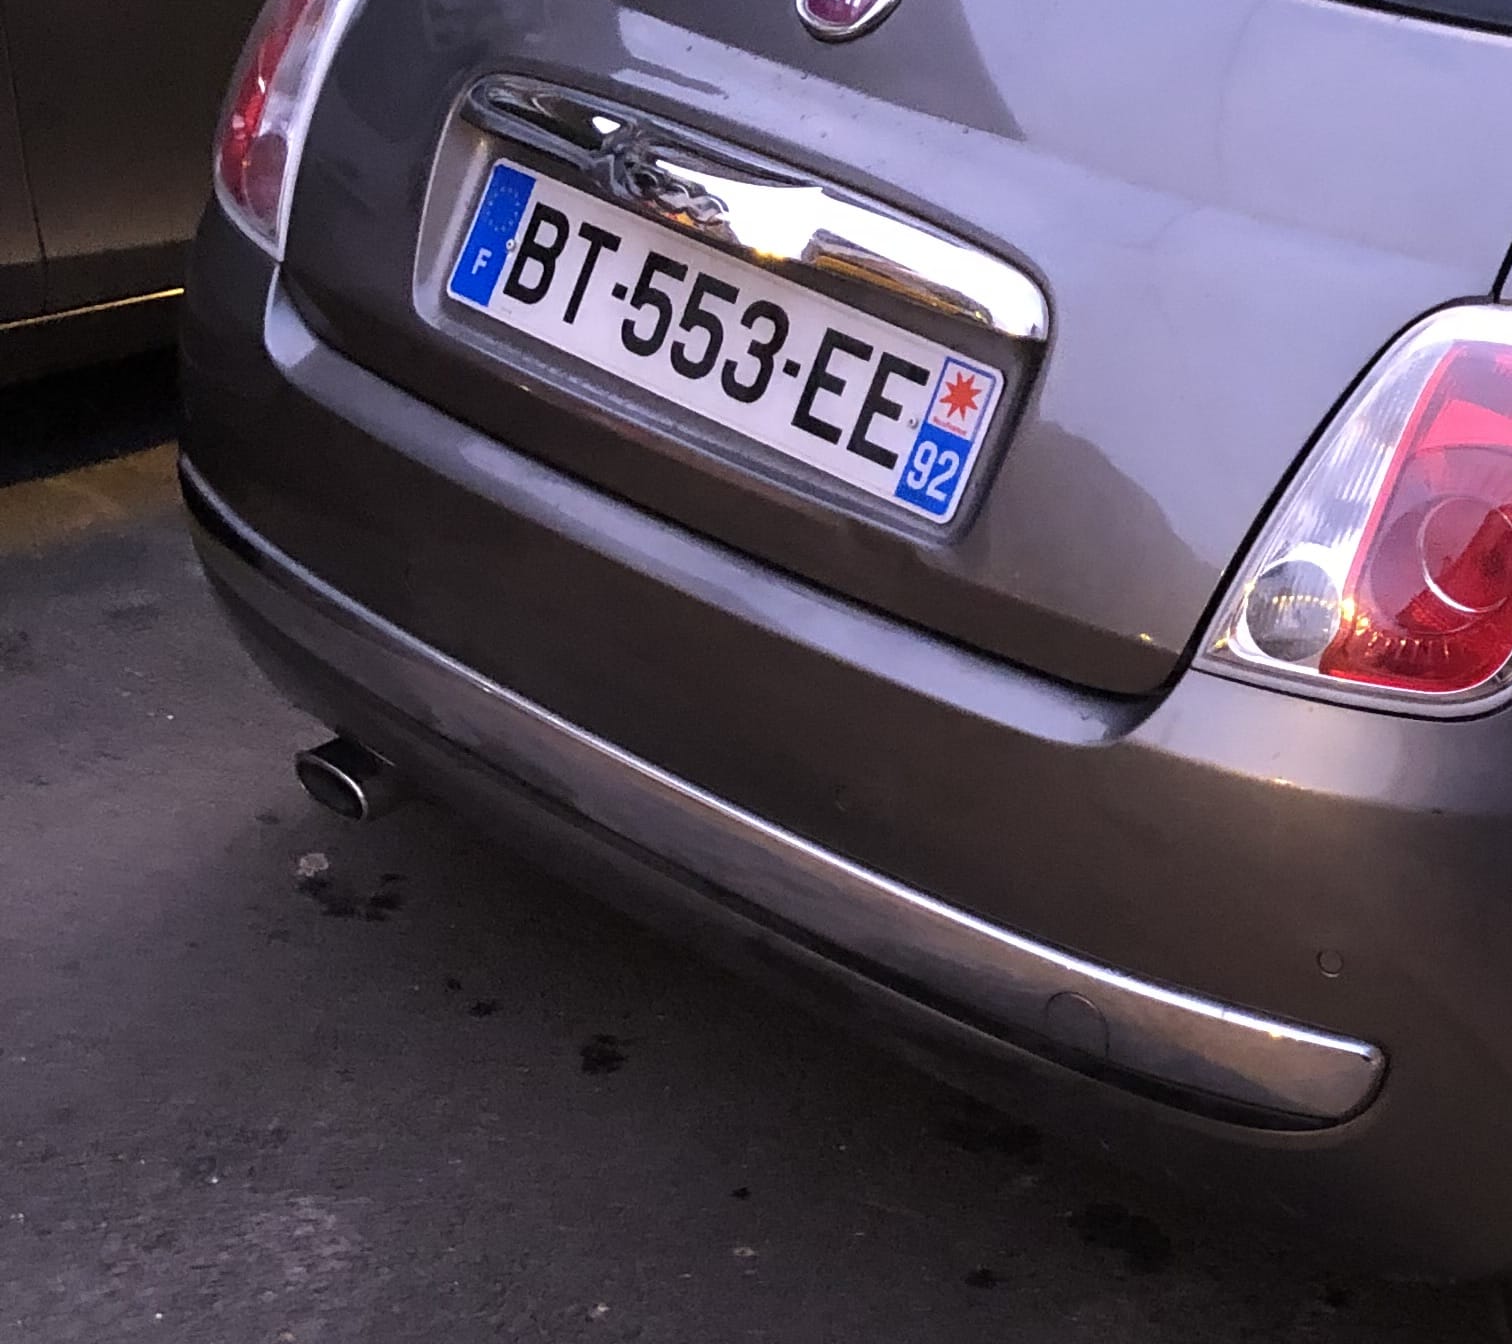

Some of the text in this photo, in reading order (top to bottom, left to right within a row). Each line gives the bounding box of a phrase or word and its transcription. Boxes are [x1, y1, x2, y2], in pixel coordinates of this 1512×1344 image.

[471, 247, 493, 275] F
[502, 201, 930, 470] BT-553-EE
[906, 440, 960, 501] 92
